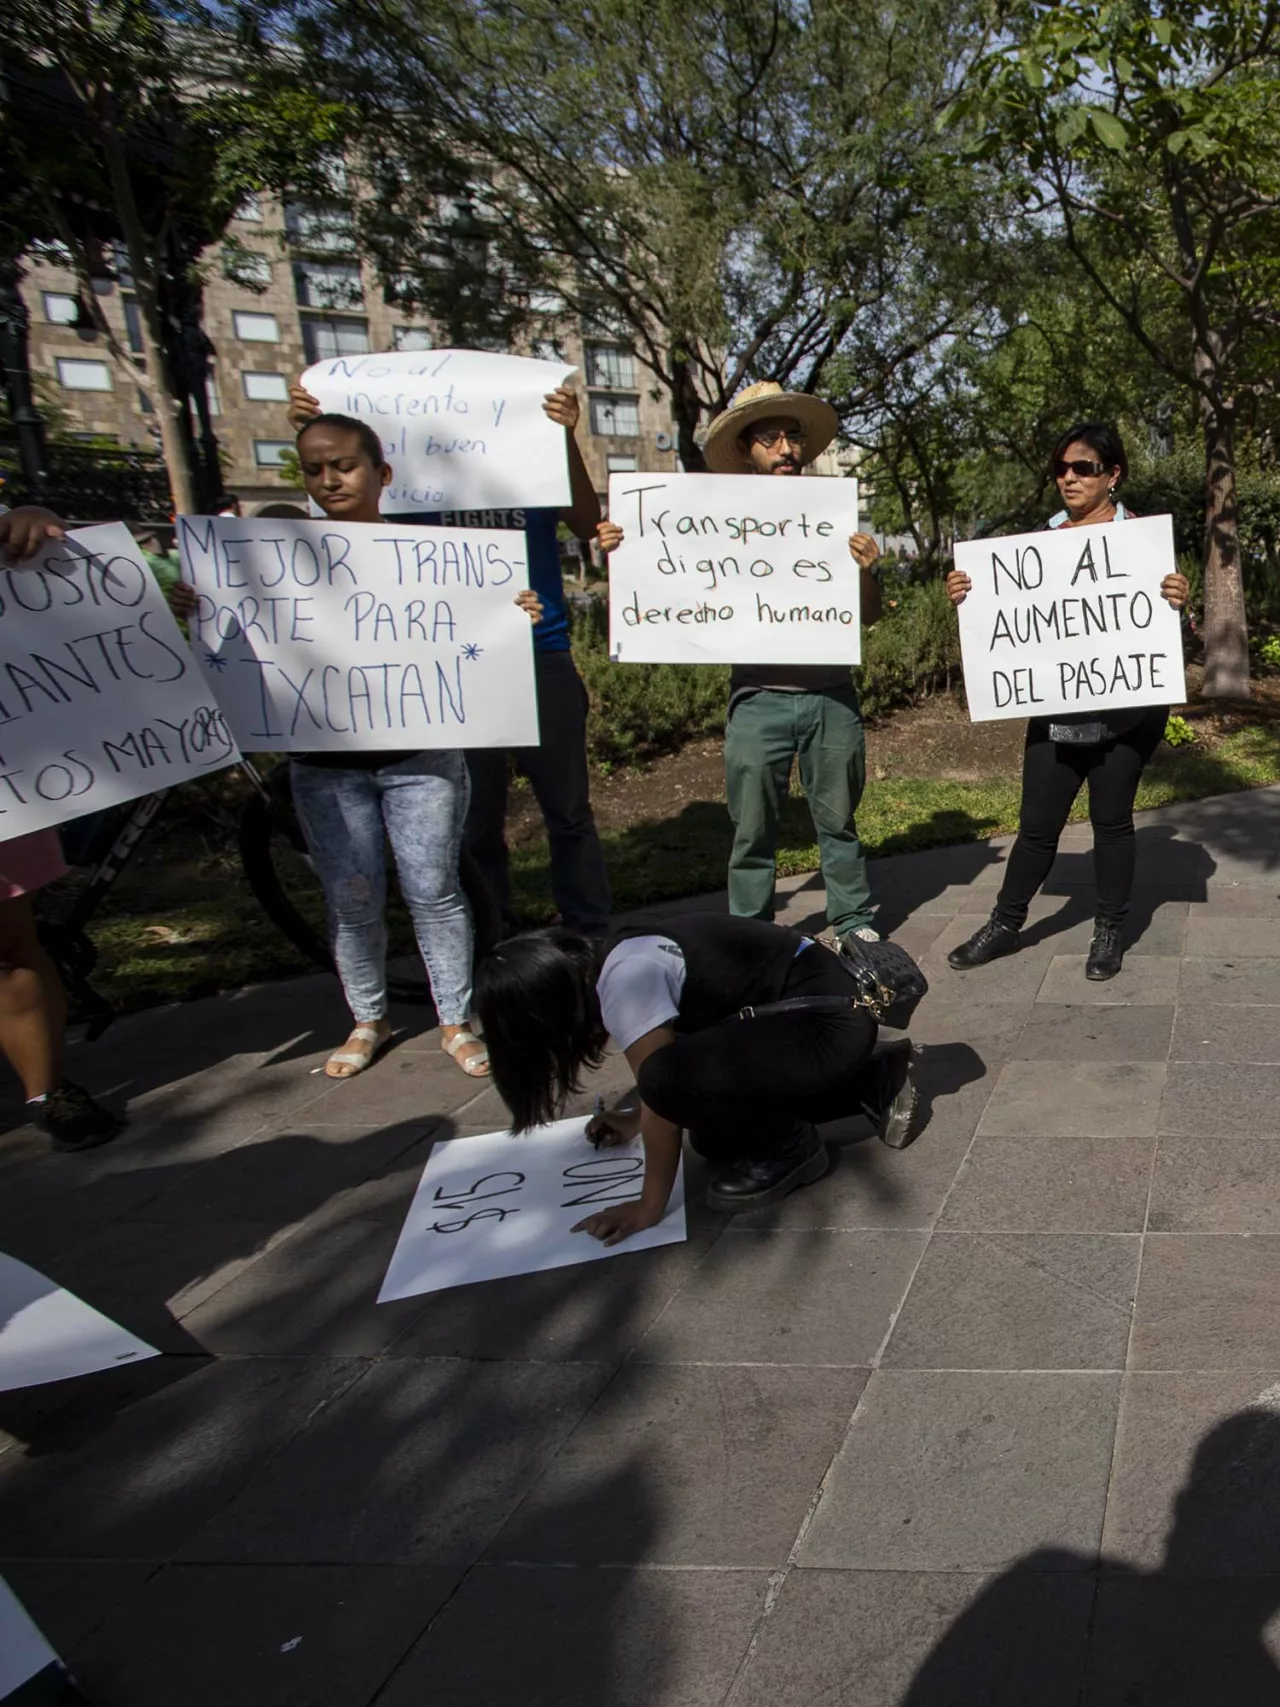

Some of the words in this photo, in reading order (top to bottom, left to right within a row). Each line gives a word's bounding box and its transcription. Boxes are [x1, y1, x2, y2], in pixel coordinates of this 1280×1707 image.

[328, 359, 391, 378] No
[408, 354, 451, 377] al
[492, 398, 506, 427] y
[425, 435, 486, 456] buen
[440, 509, 526, 528] FIGHTS
[622, 484, 834, 544] Transporte
[181, 518, 357, 588] MEJOR
[373, 539, 525, 587] TRANS-
[657, 540, 773, 590] digno
[793, 559, 833, 582] es
[992, 545, 1043, 596] NO
[1070, 536, 1131, 586] AL
[196, 594, 315, 643] PORTE
[344, 591, 456, 642] PARA
[622, 591, 734, 626] derecho
[756, 593, 853, 625] humano
[990, 590, 1153, 652] AUMENTO
[993, 668, 1044, 708] DEL
[1057, 653, 1167, 700] PASAJE
[0, 750, 94, 813] TOS
